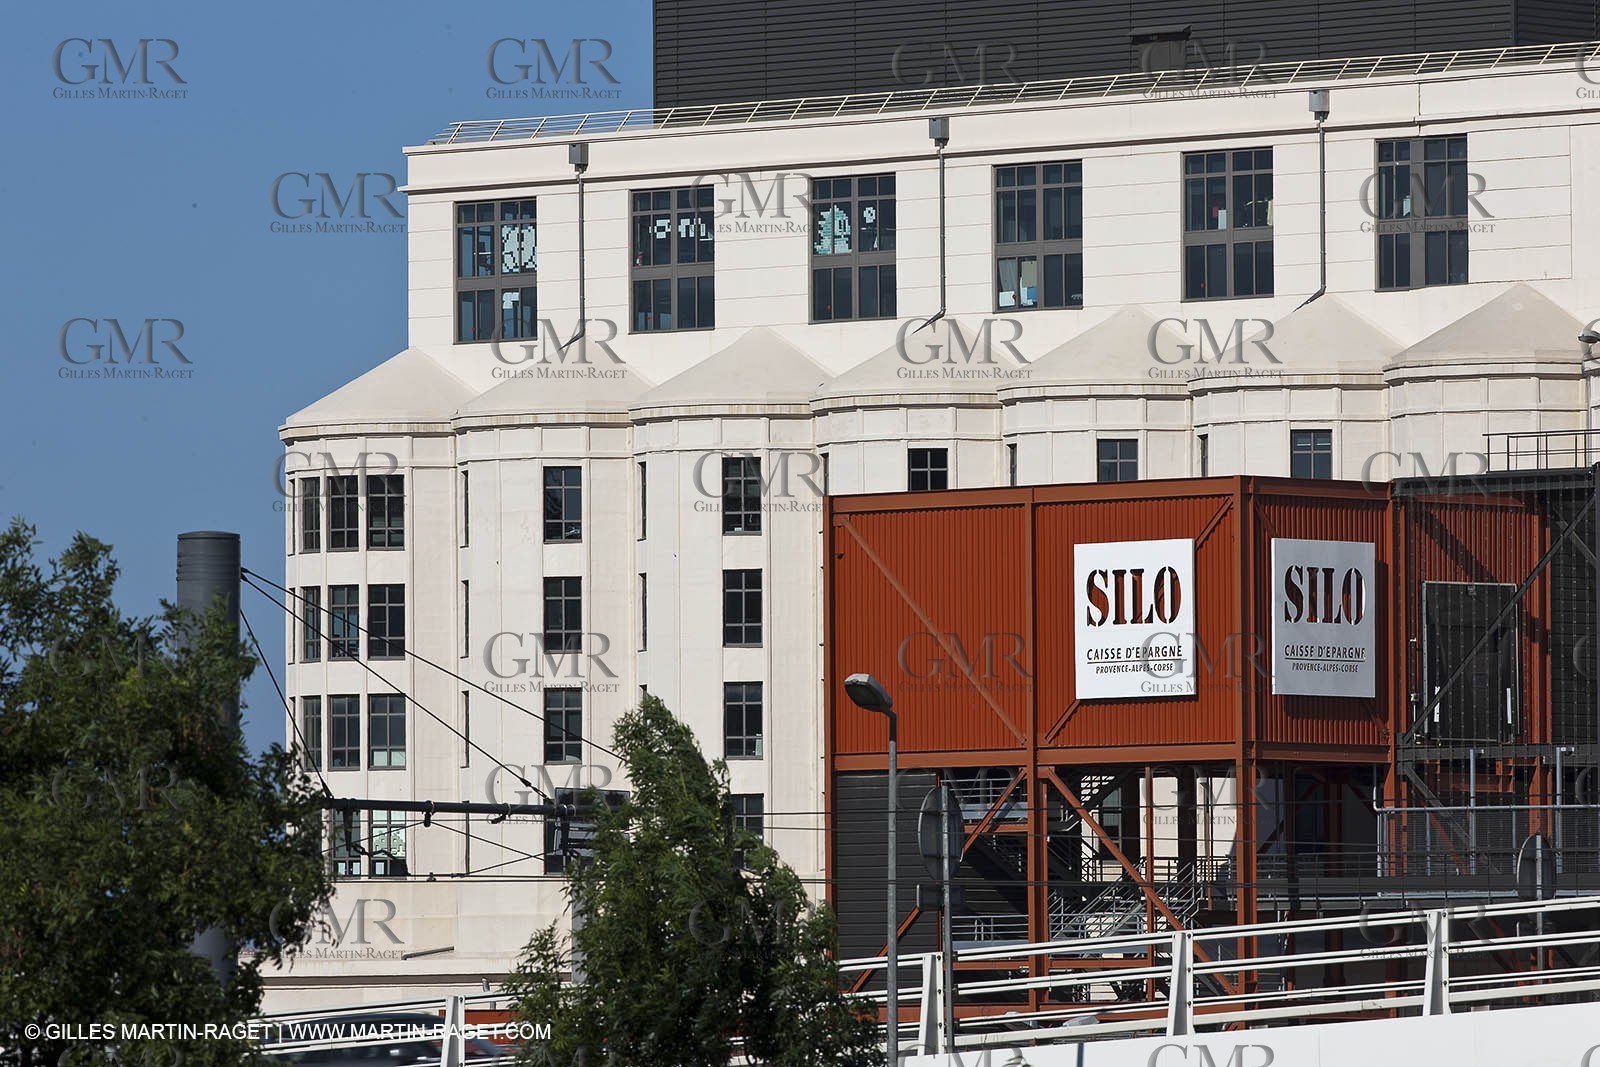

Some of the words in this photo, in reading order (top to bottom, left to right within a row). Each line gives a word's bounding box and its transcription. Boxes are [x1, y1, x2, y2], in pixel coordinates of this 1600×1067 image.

[1086, 566, 1182, 627] SILO
[1284, 565, 1366, 626] SILO
[1087, 648, 1122, 661] CAISSE
[1126, 645, 1183, 659] D'EPARGNE
[1284, 644, 1314, 657] CAISSE
[1095, 662, 1174, 674] PROVENCE-ALPES-CORSE
[1292, 662, 1359, 673] PROVENCE-ALPES-CORSE
